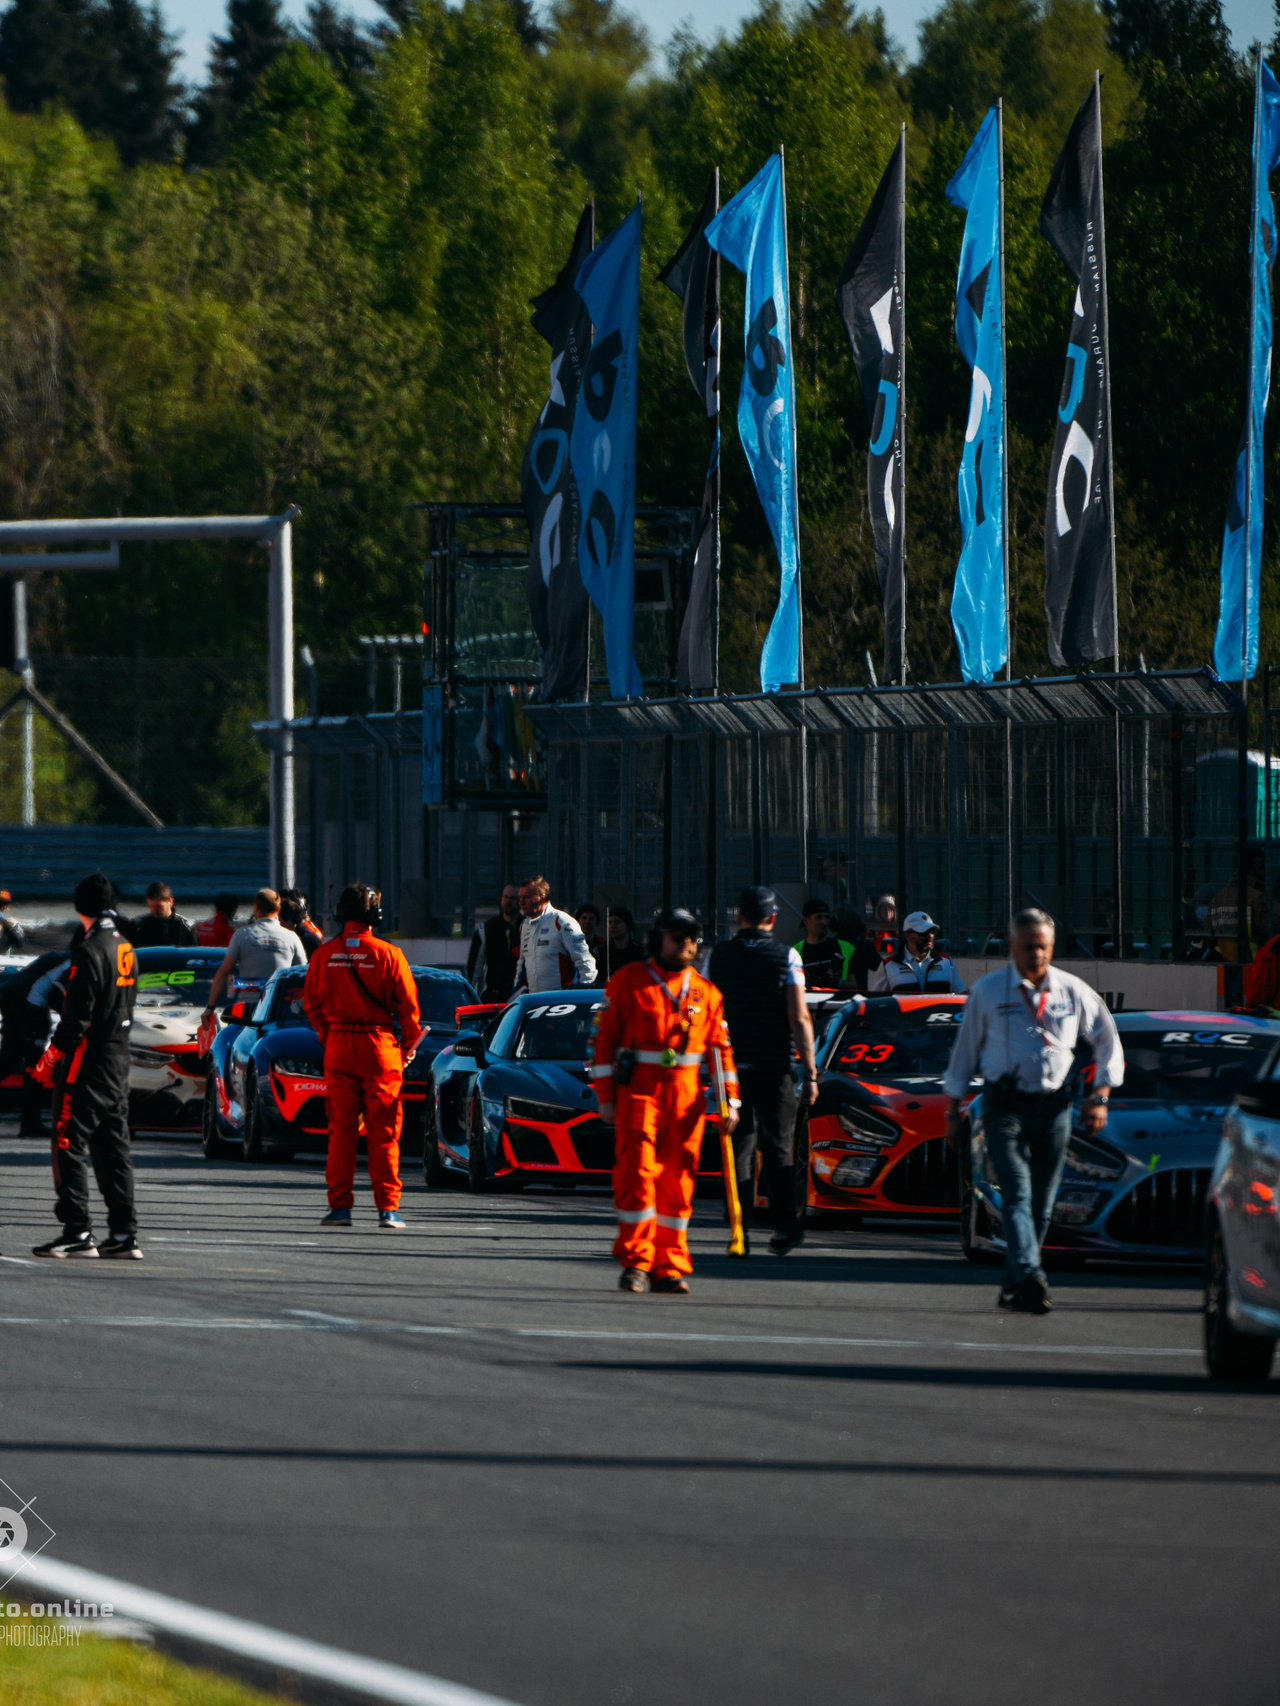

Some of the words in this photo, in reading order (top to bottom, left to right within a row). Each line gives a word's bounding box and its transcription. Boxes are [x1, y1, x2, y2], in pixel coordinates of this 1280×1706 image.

[136, 970, 196, 989] 26
[526, 1003, 578, 1019] 19
[840, 1043, 895, 1063] 33
